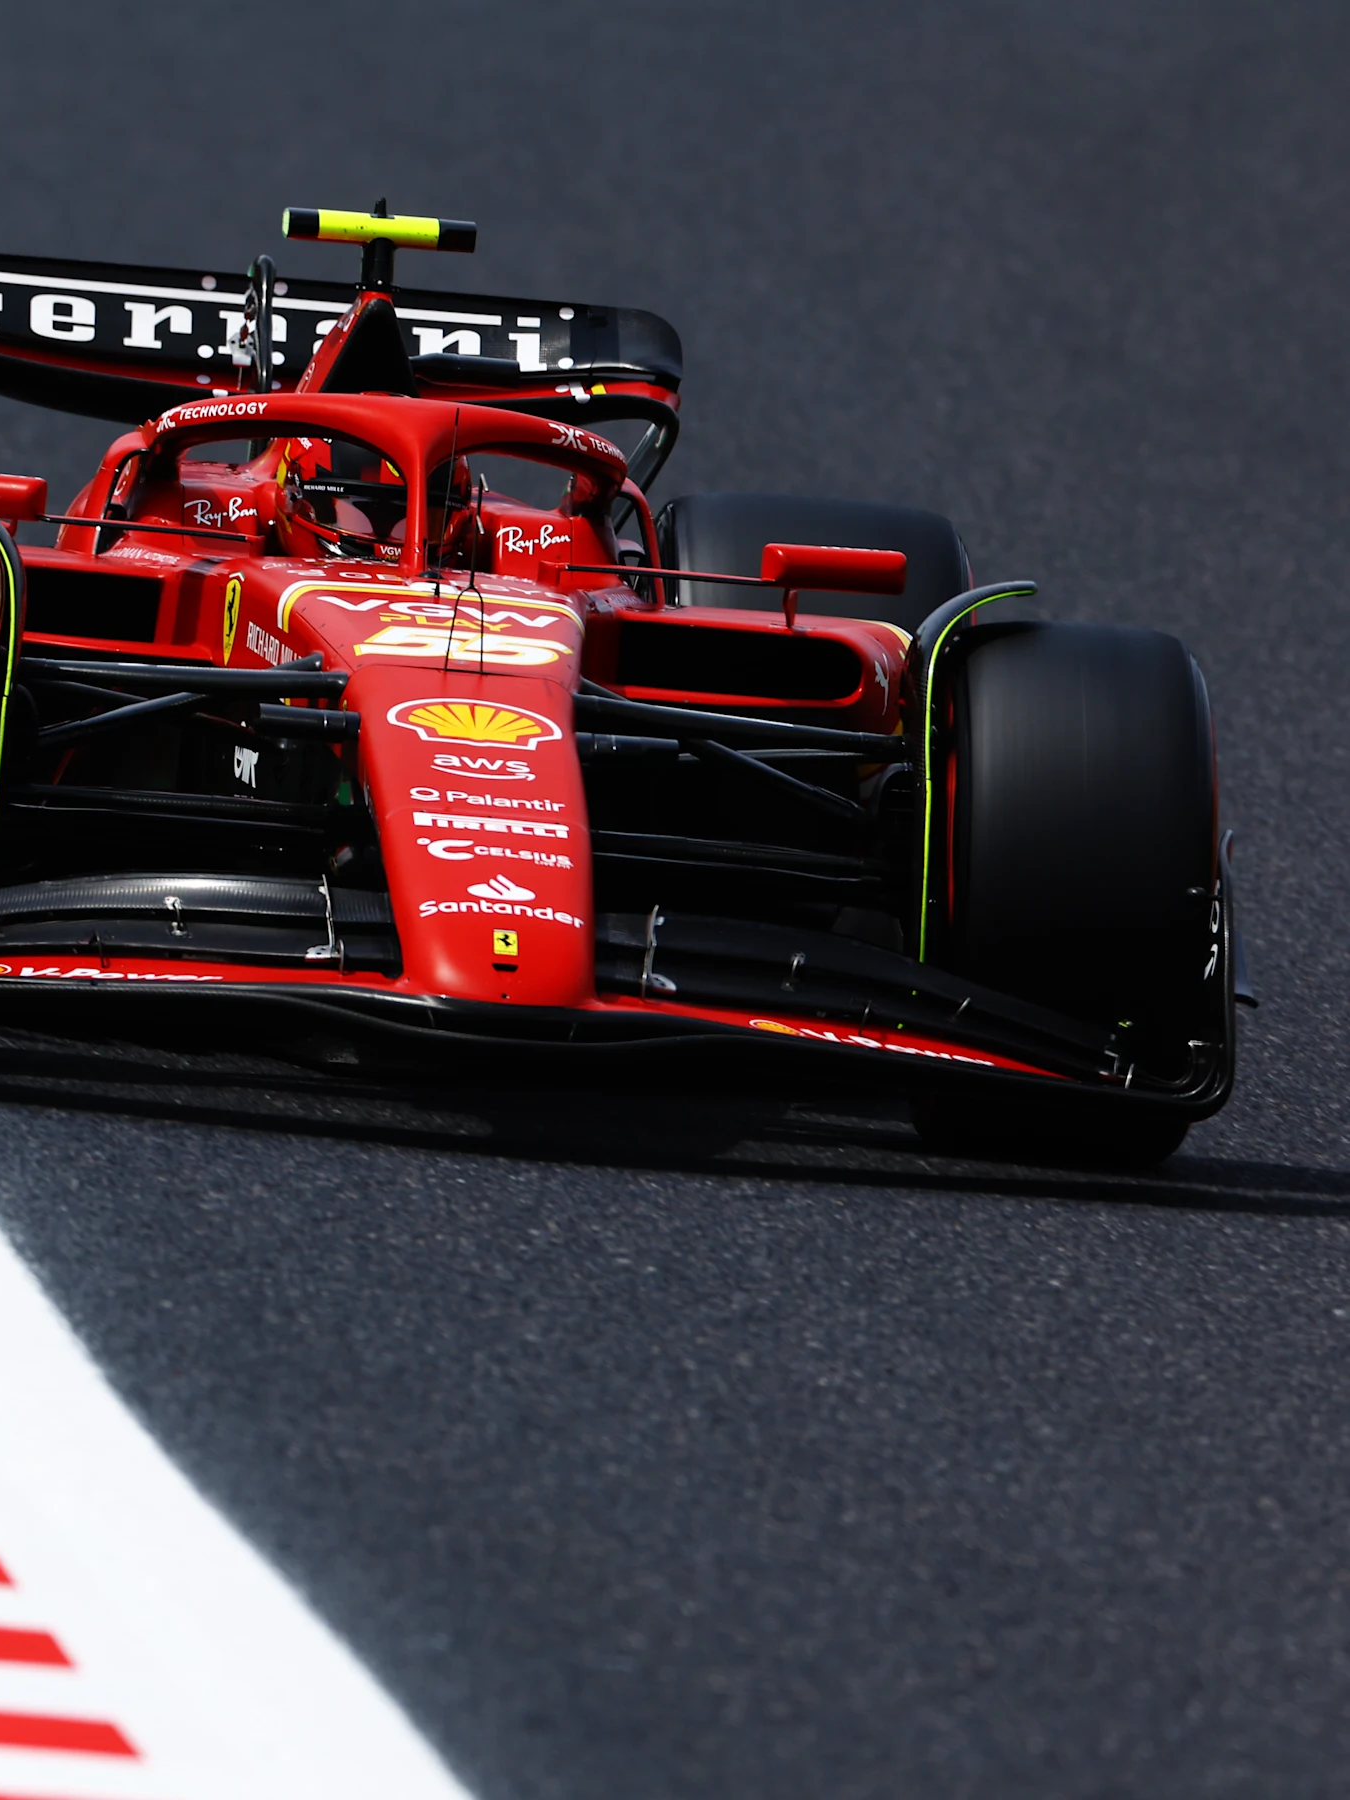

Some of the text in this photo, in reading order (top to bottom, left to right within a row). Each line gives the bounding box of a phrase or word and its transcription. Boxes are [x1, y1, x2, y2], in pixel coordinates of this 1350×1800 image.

[179, 402, 268, 420] TECHNOLOGY
[184, 497, 258, 528] Ray-Ban
[496, 524, 571, 555] Ray-Ban
[317, 596, 559, 628] VGW
[379, 612, 512, 632] PLAY
[247, 620, 280, 667] RICHARD
[353, 625, 573, 667] 55
[433, 753, 531, 773] aws
[445, 790, 566, 813] Palantir
[412, 811, 570, 839] PIRELLI
[473, 845, 573, 867] CELSIUS
[418, 900, 585, 929] Santander
[19, 966, 224, 982] V-Power
